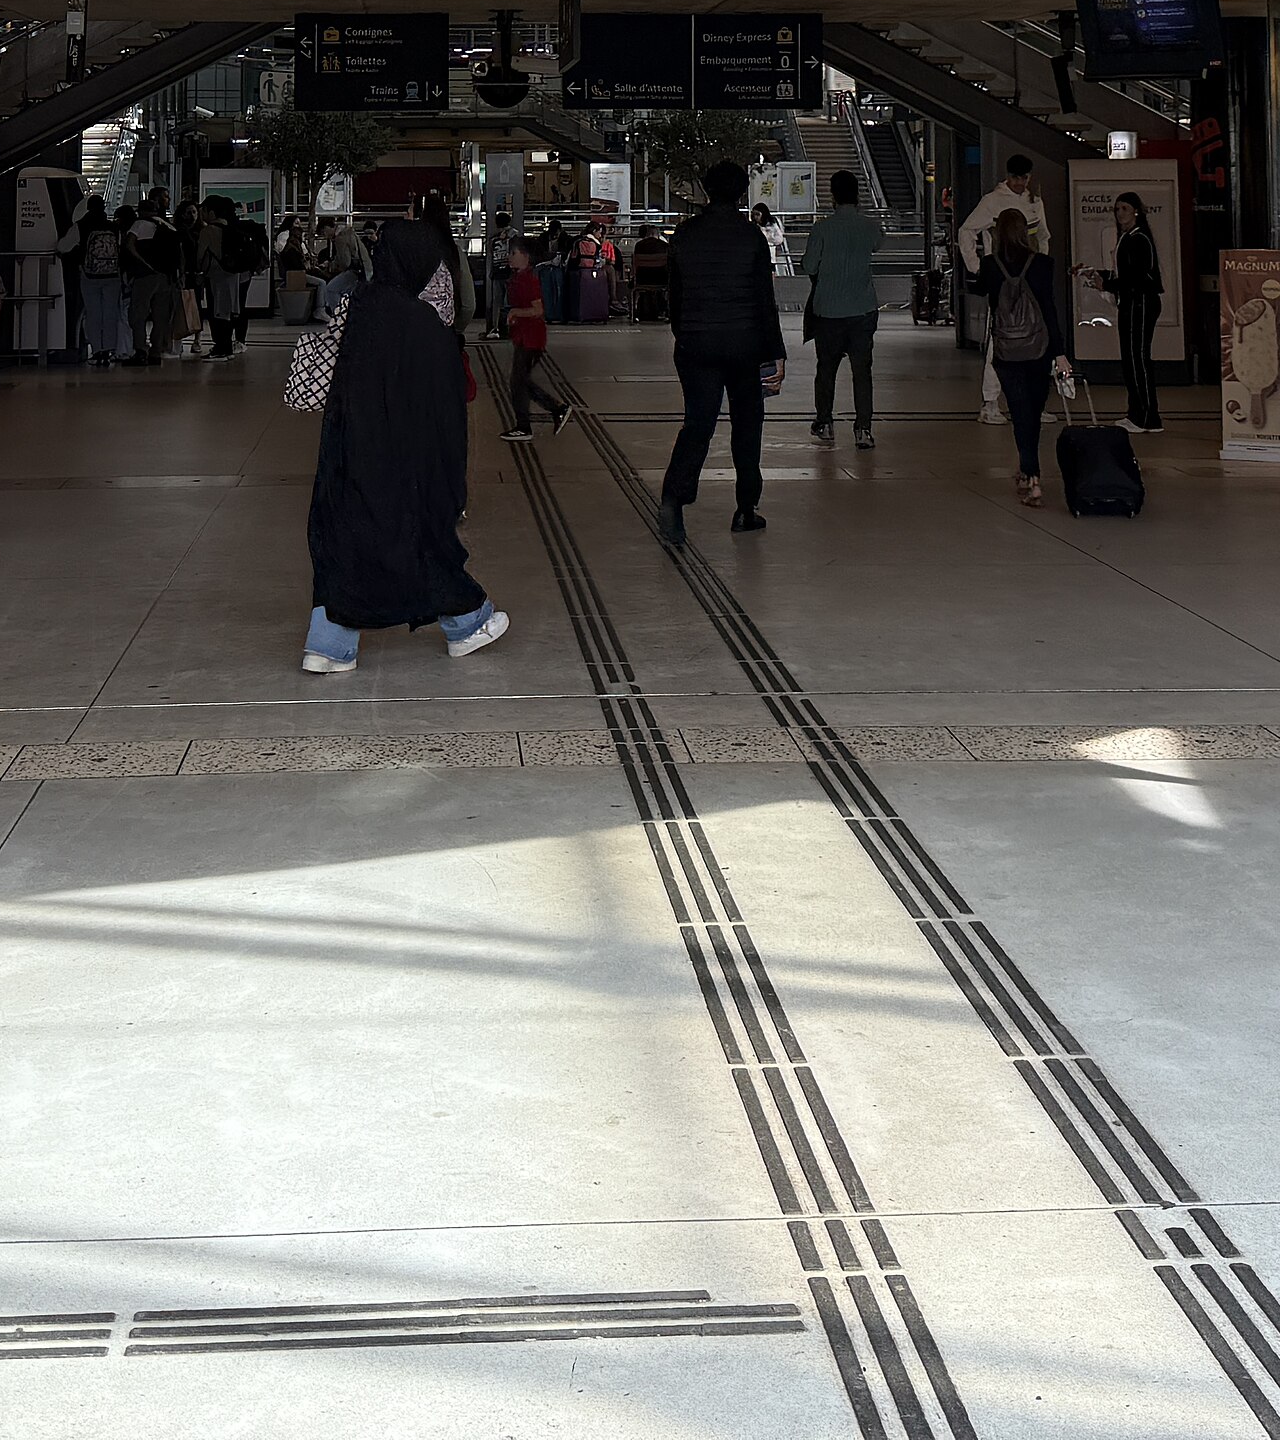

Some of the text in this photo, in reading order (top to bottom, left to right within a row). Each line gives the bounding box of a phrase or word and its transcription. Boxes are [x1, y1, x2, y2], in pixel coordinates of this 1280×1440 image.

[345, 27, 393, 38] Consignes
[702, 33, 772, 44] Disney Express
[346, 56, 387, 66] Toilettes
[700, 55, 772, 66] Embarquement
[370, 85, 399, 95] Trains
[614, 83, 640, 93] Salle
[724, 83, 771, 93] Ascenseur
[1225, 260, 1280, 271] MAGNUM
